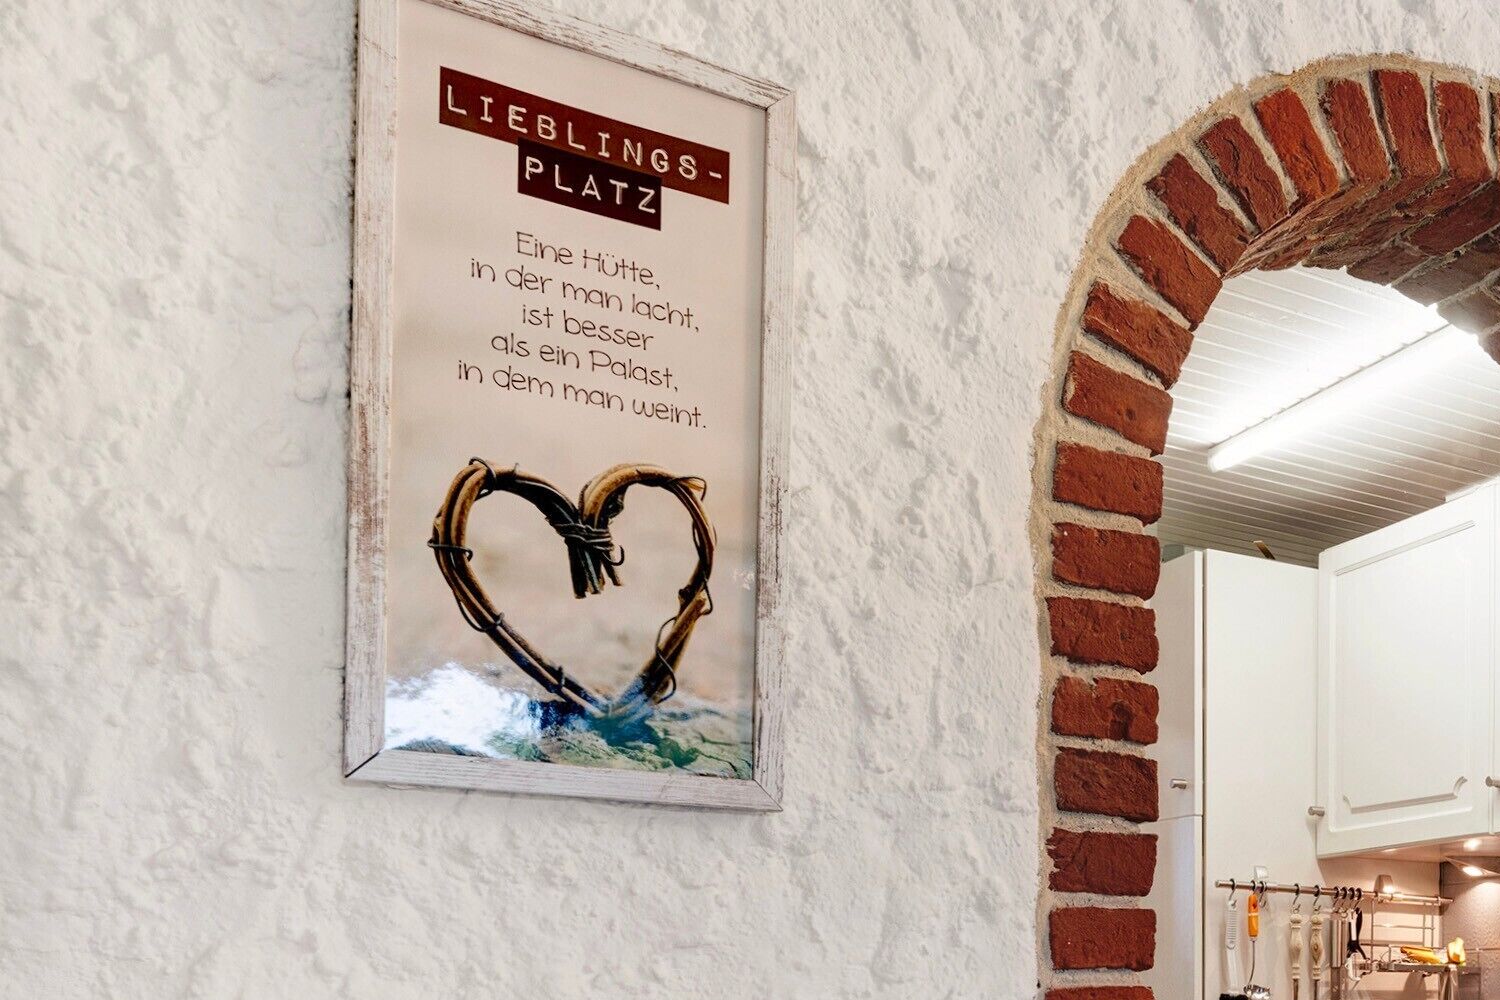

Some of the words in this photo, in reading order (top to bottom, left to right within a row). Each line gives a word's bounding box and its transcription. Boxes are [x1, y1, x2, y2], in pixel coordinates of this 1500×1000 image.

[447, 85, 722, 180] LIEBLINGS-
[525, 156, 656, 214] PLATZ
[516, 231, 573, 265] Eine
[582, 249, 660, 290] Hütte,
[470, 258, 496, 282] in
[505, 265, 553, 294] der
[562, 281, 623, 312] man
[632, 294, 699, 332] lacht,
[522, 304, 554, 328] ist
[563, 310, 654, 350] besser
[491, 333, 530, 357] als
[540, 345, 580, 369] ein
[589, 350, 678, 392] Palast,
[458, 360, 483, 384] in
[492, 365, 553, 398] dem
[563, 384, 624, 412] man
[632, 399, 707, 429] weint.
